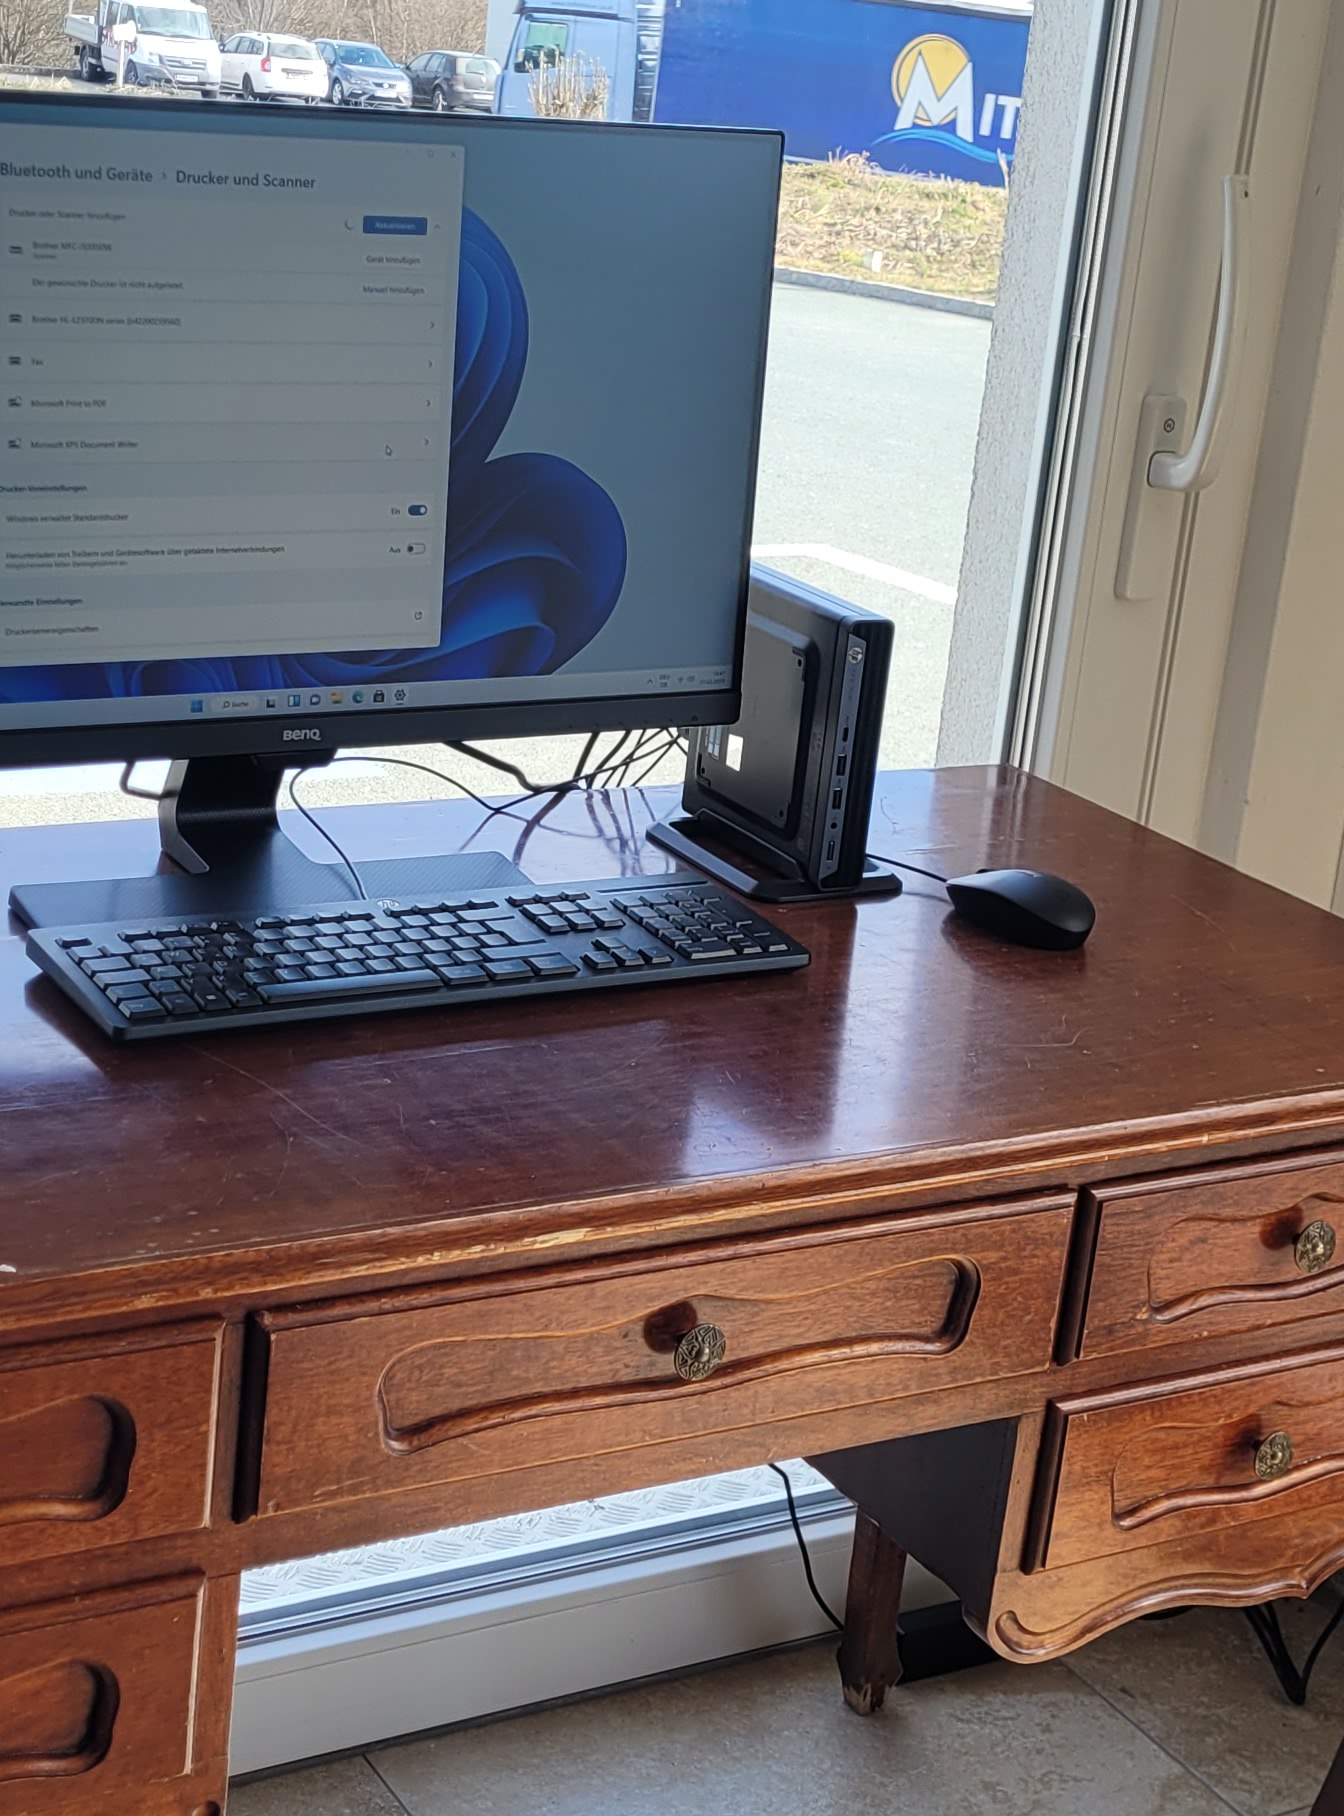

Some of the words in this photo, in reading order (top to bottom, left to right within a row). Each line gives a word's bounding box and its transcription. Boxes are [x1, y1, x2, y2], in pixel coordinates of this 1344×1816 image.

[0, 162, 71, 179] Bluetooth
[75, 166, 102, 181] und
[106, 166, 153, 183] Geräte
[175, 170, 229, 186] Drucker
[233, 173, 259, 187] und
[263, 174, 316, 189] Scanner
[391, 507, 401, 516] Ein
[389, 546, 401, 554] Aus
